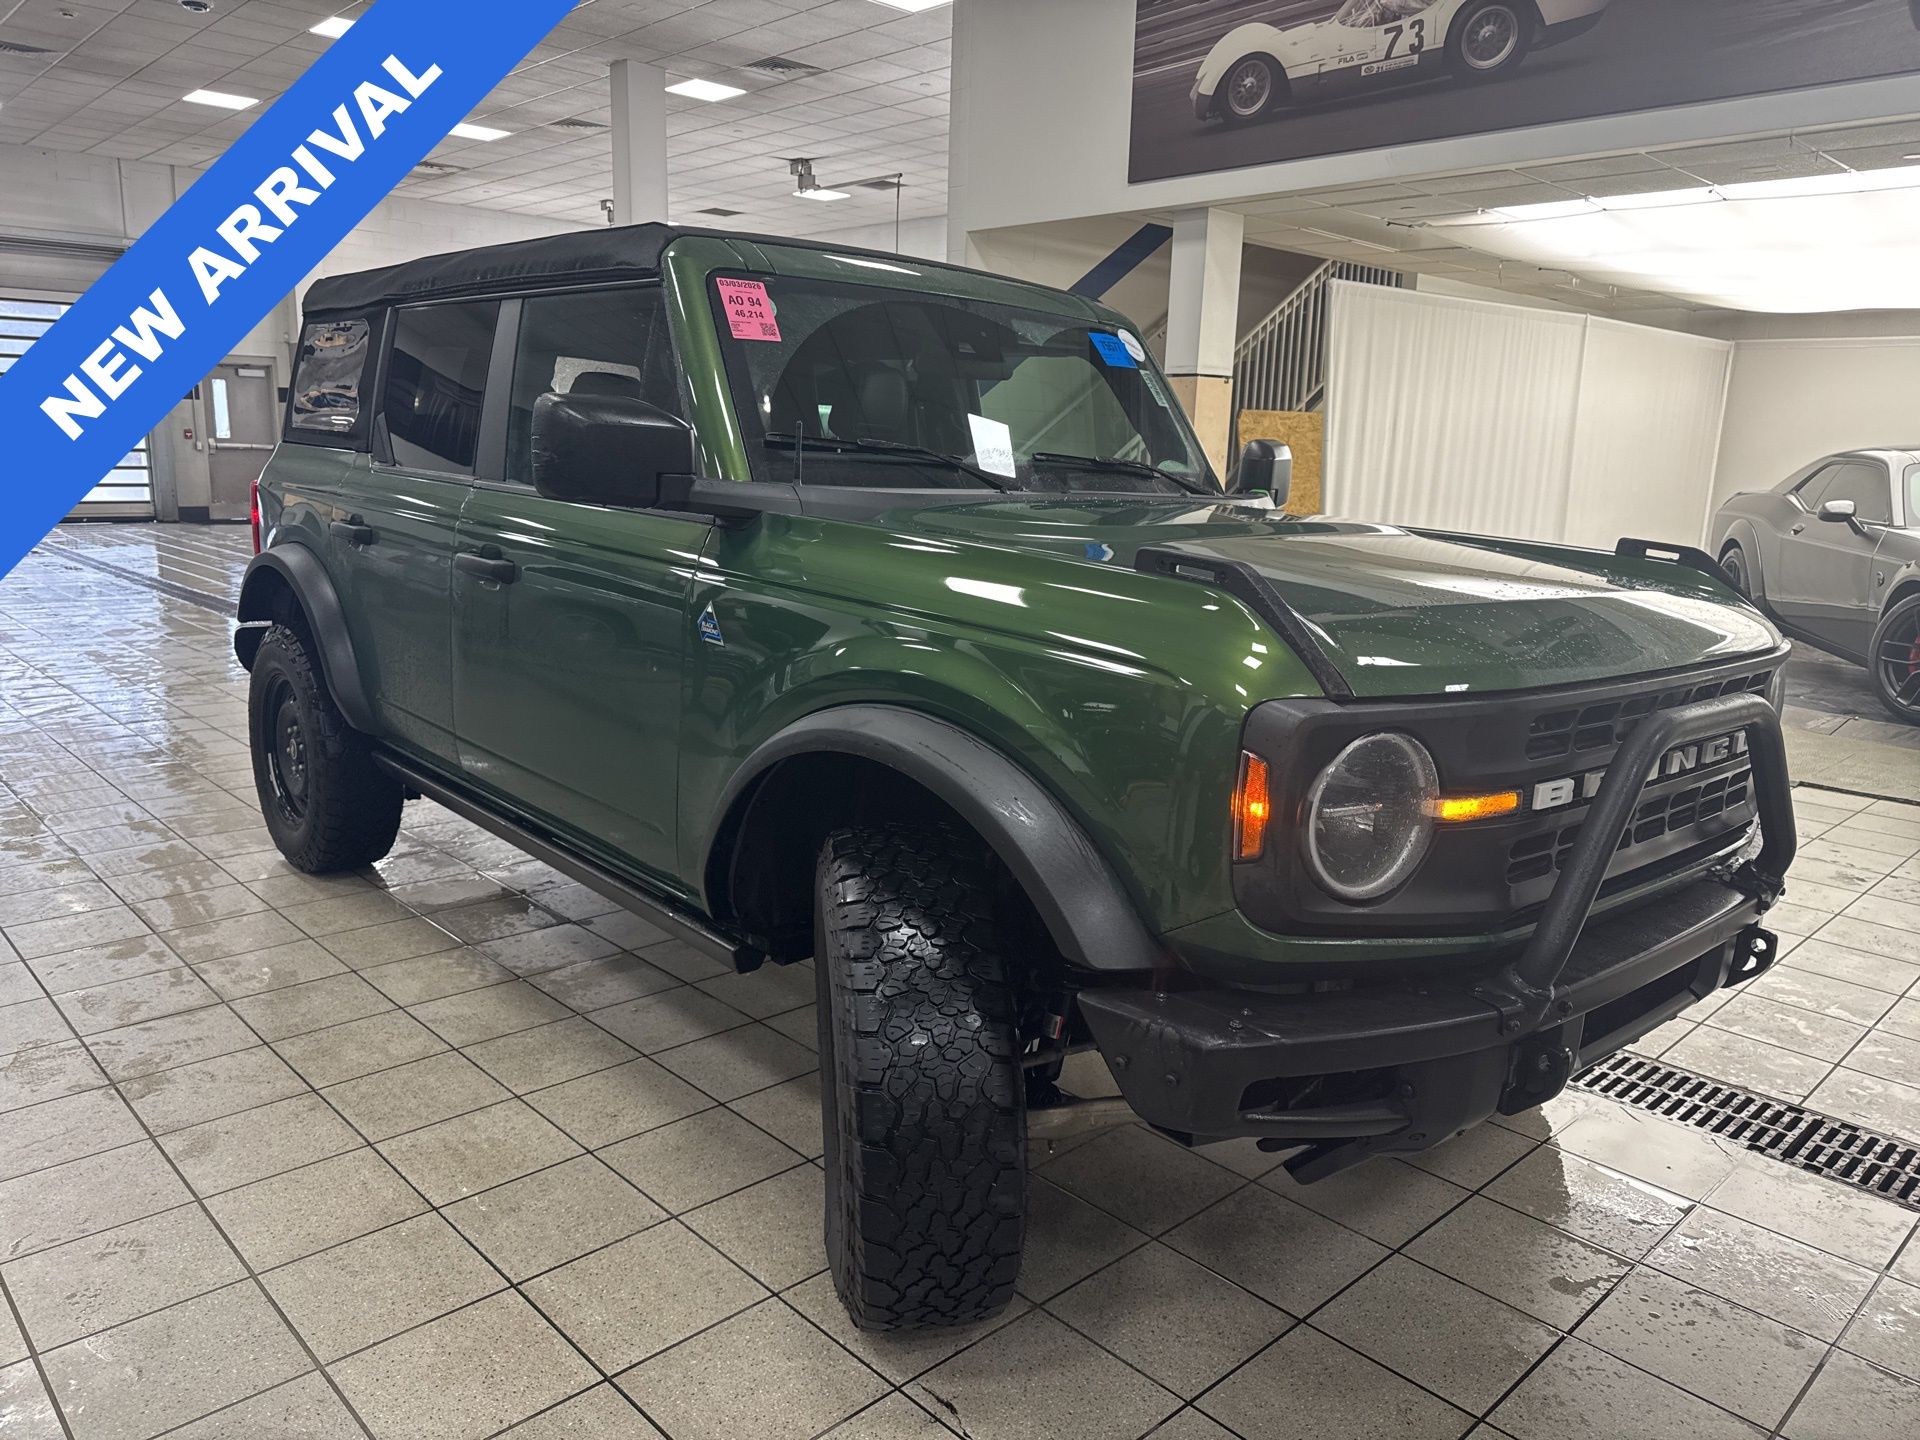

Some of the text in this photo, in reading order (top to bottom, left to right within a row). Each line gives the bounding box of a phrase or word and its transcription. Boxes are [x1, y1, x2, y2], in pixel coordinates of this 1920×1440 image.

[1384, 18, 1425, 60] 73
[1338, 55, 1355, 65] FILA
[719, 280, 761, 289] 03/03/2026
[748, 297, 762, 306] 94
[1532, 728, 1749, 810] BNC
